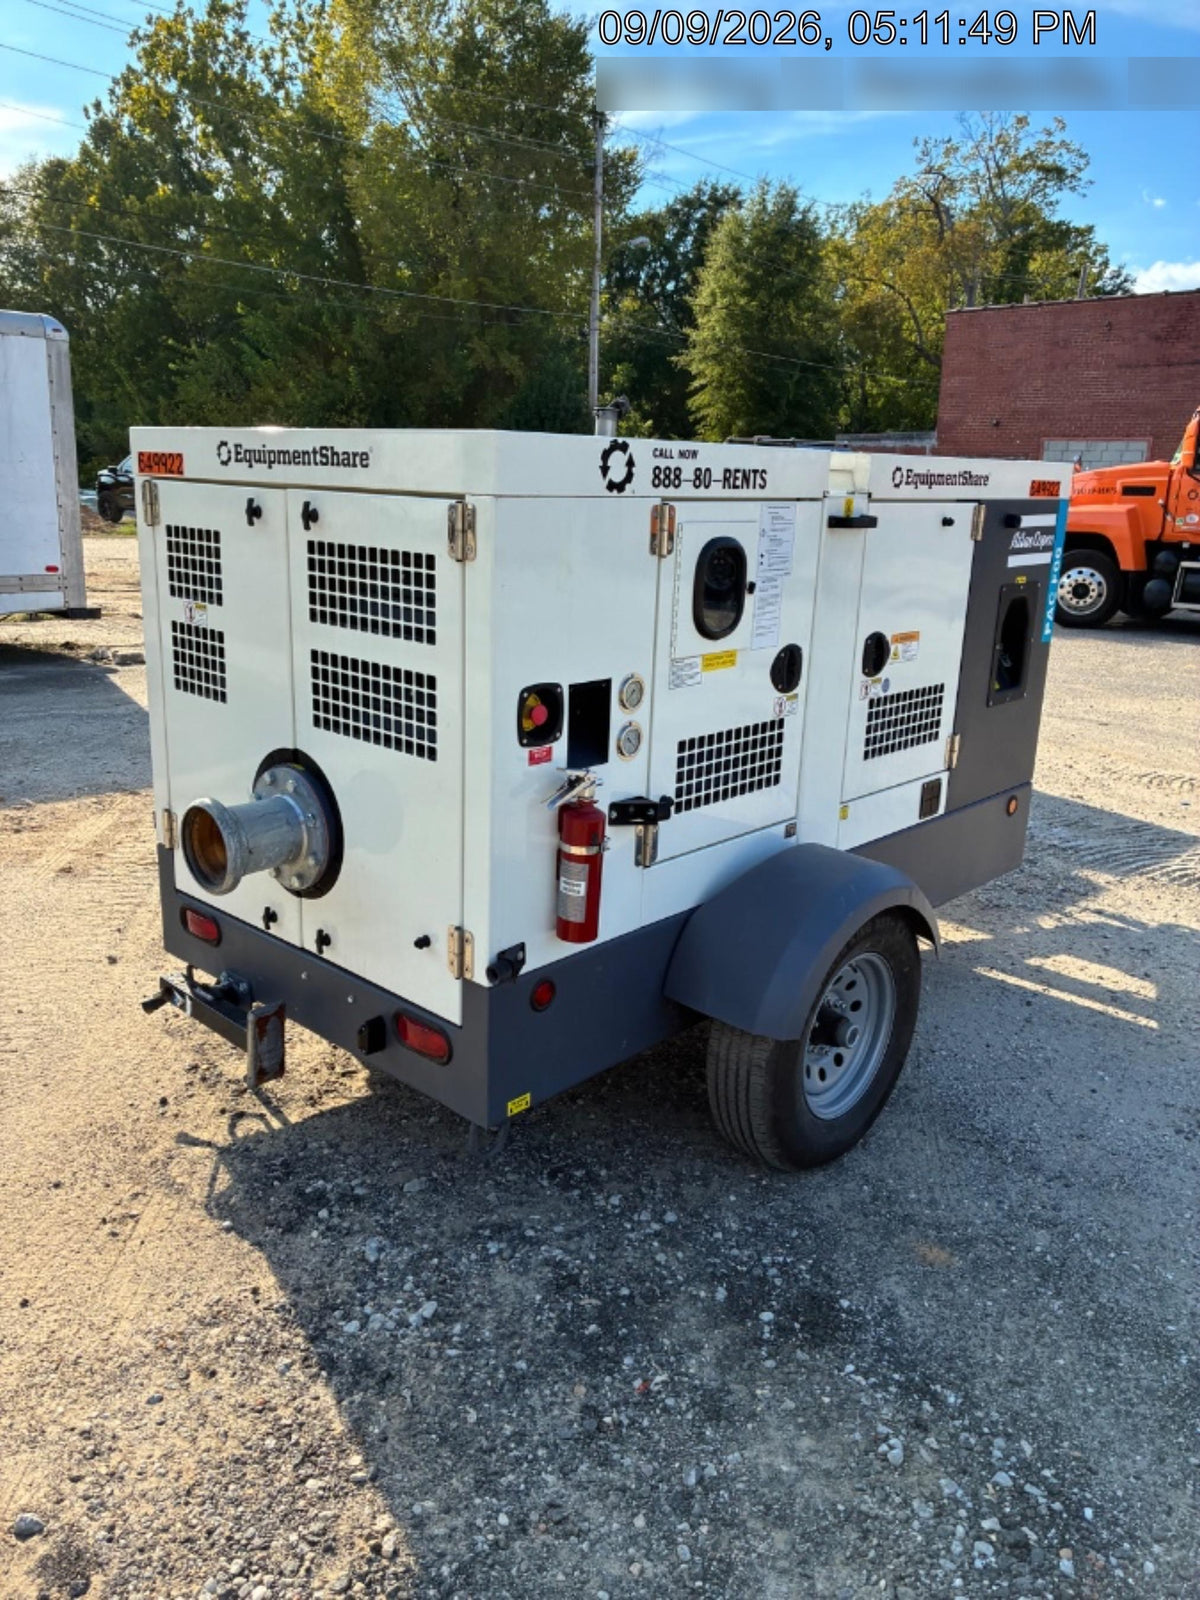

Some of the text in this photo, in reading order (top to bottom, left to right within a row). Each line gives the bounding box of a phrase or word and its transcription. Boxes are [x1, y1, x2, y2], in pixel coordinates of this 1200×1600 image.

[138, 452, 184, 475] 649922
[234, 444, 370, 469] EquipmentShare
[652, 447, 699, 460] CALL NOW
[651, 466, 768, 490] 888-80-RENTS
[905, 469, 990, 489] EquipmentShare
